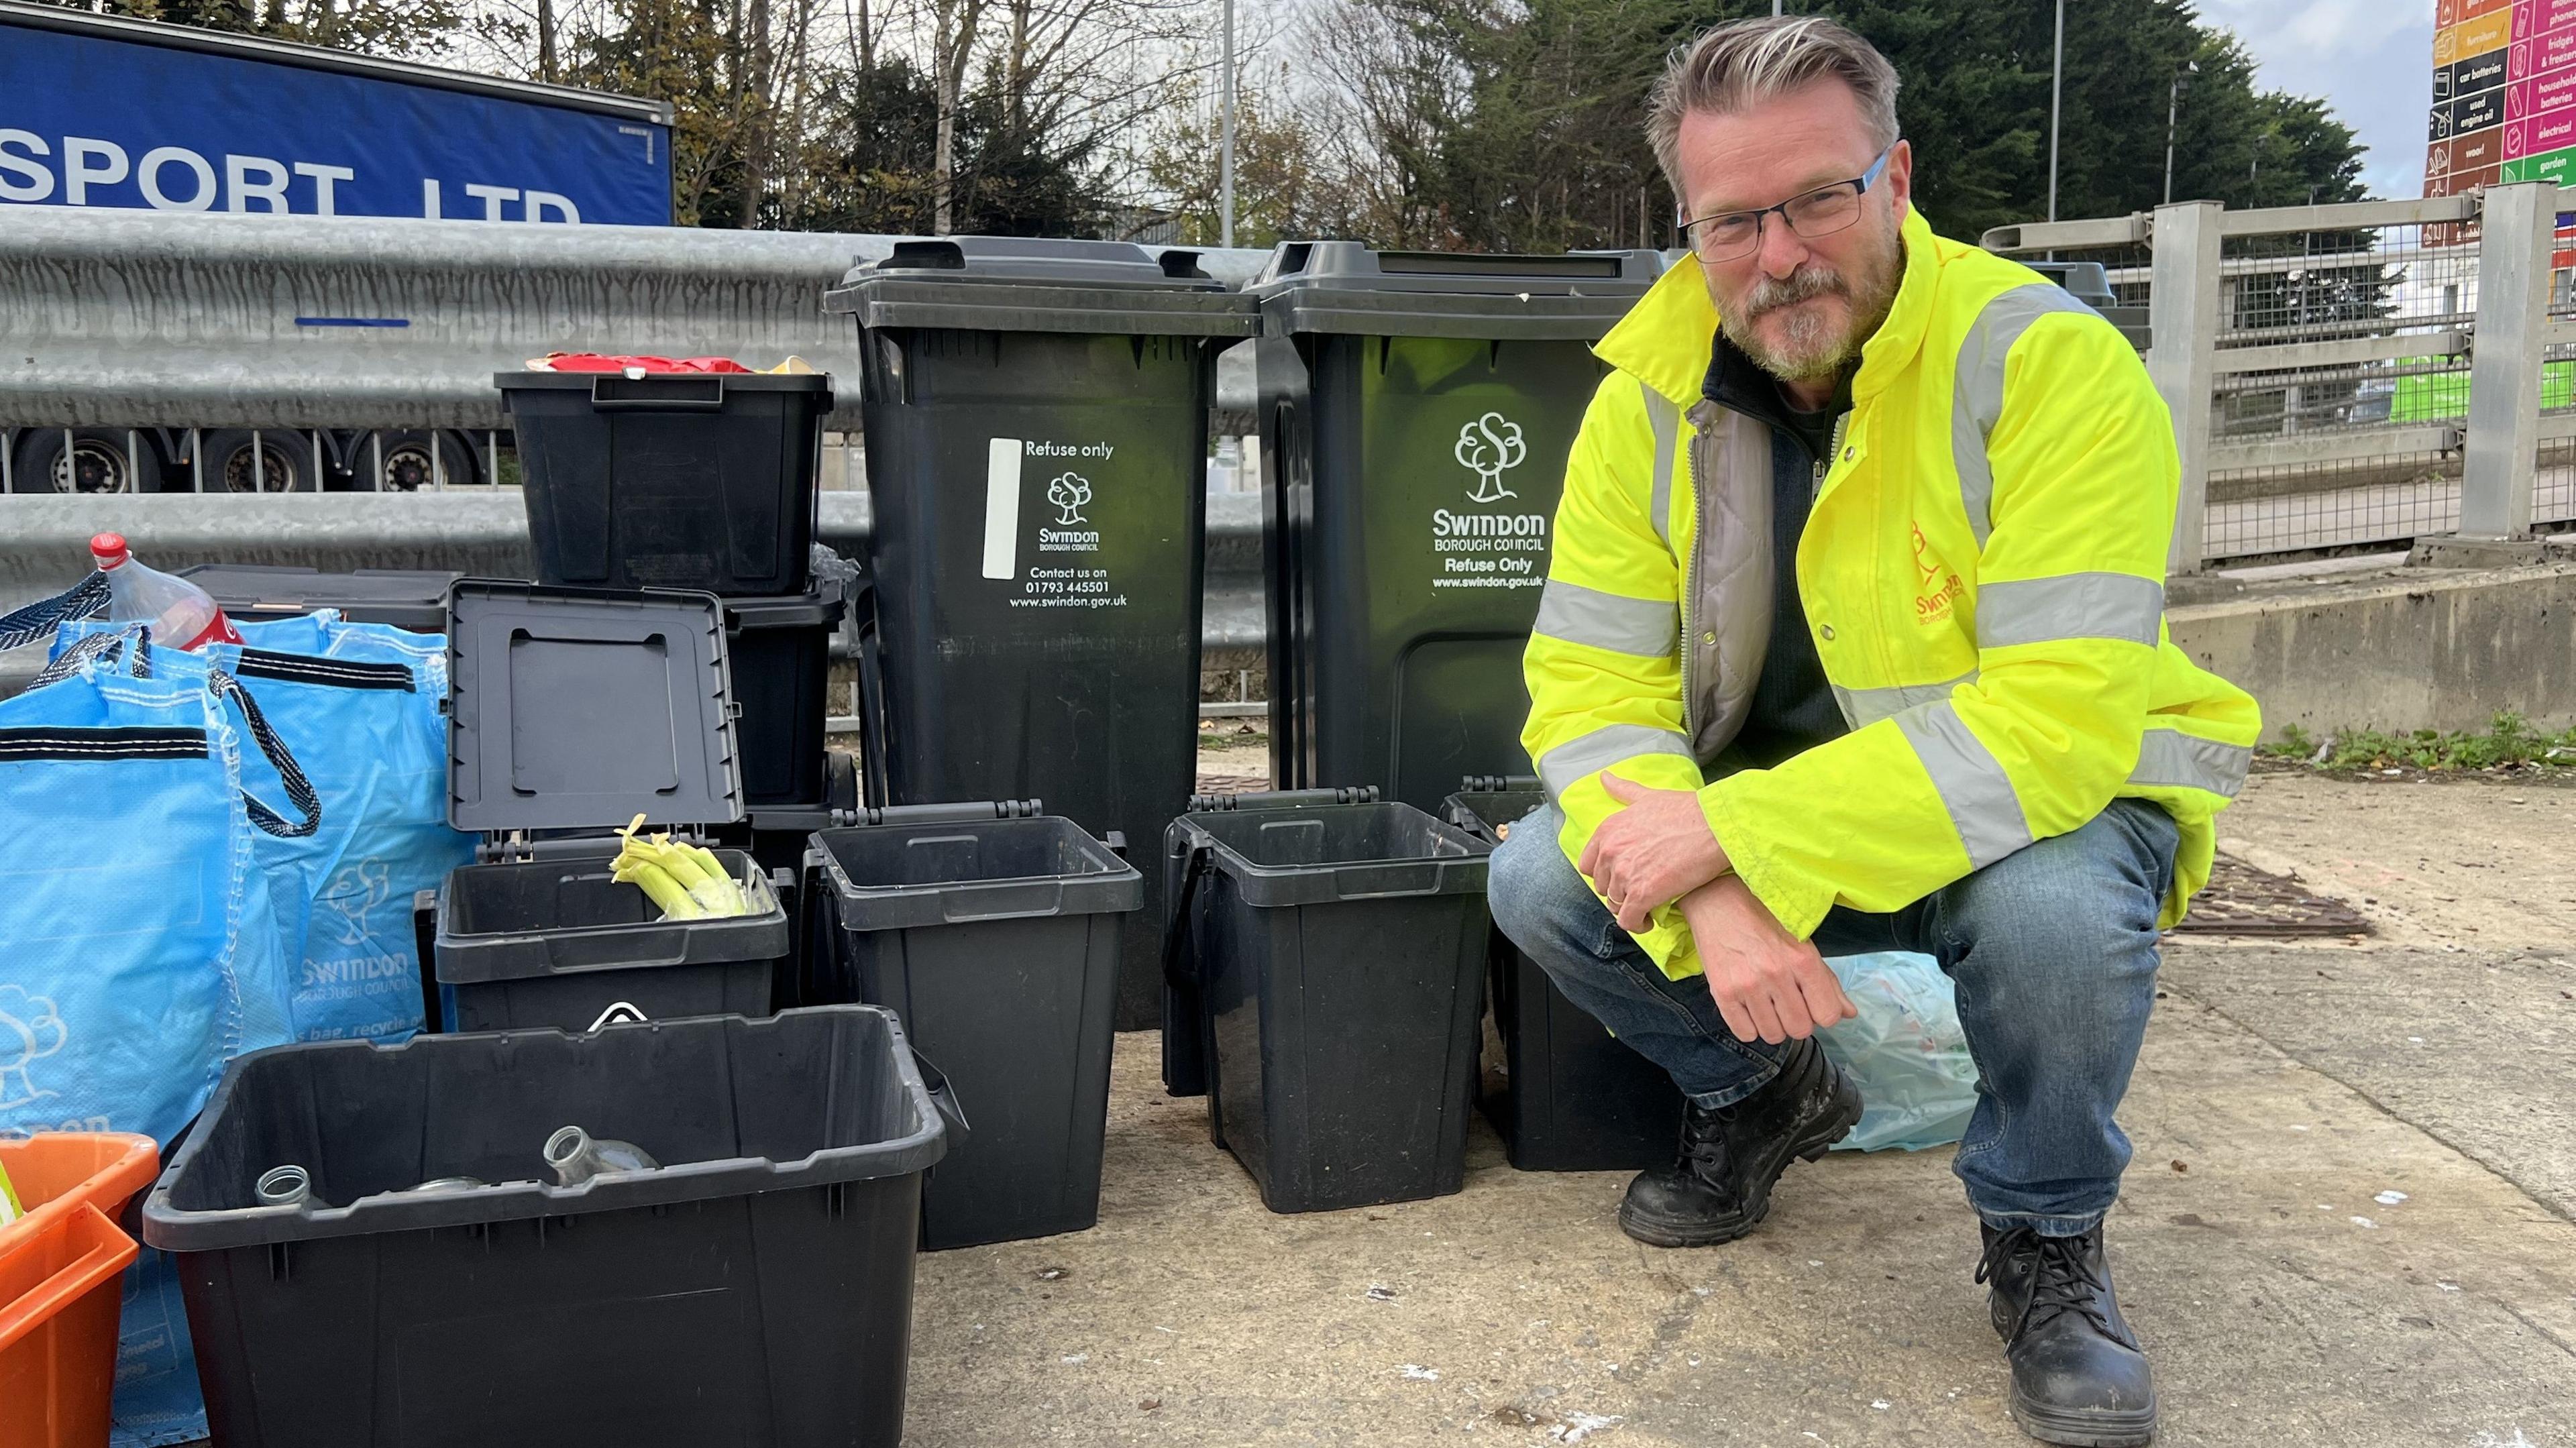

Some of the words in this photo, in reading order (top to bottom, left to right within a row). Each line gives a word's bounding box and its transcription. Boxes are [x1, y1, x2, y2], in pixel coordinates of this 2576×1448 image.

[2548, 36, 2574, 50] fridges
[2541, 56, 2547, 68] &
[2549, 51, 2576, 66] freezer
[2459, 74, 2471, 84] car
[2471, 63, 2502, 80] batteries
[2469, 96, 2486, 111] used
[2540, 92, 2573, 109] batteries
[2460, 113, 2483, 127] engine
[2484, 108, 2494, 121] oil
[2538, 121, 2572, 140] electrical
[0, 128, 354, 215] SPORT
[2540, 156, 2567, 174] garden
[1026, 441, 1077, 457] Refuse
[1081, 441, 1114, 461] only
[1039, 543, 1071, 551] BOROUGH
[1434, 539, 1491, 552] BOROUGH
[1030, 567, 1075, 579] Contact
[1077, 569, 1090, 578] us
[1092, 569, 1107, 577] on
[1444, 558, 1496, 573] Refuse
[1499, 557, 1533, 575] Only
[1026, 583, 1064, 594] 01793
[1067, 581, 1109, 593] 445501
[1432, 575, 1544, 590] www.swindon.gov.uk
[1010, 594, 1127, 609] www.swindon.gov.uk
